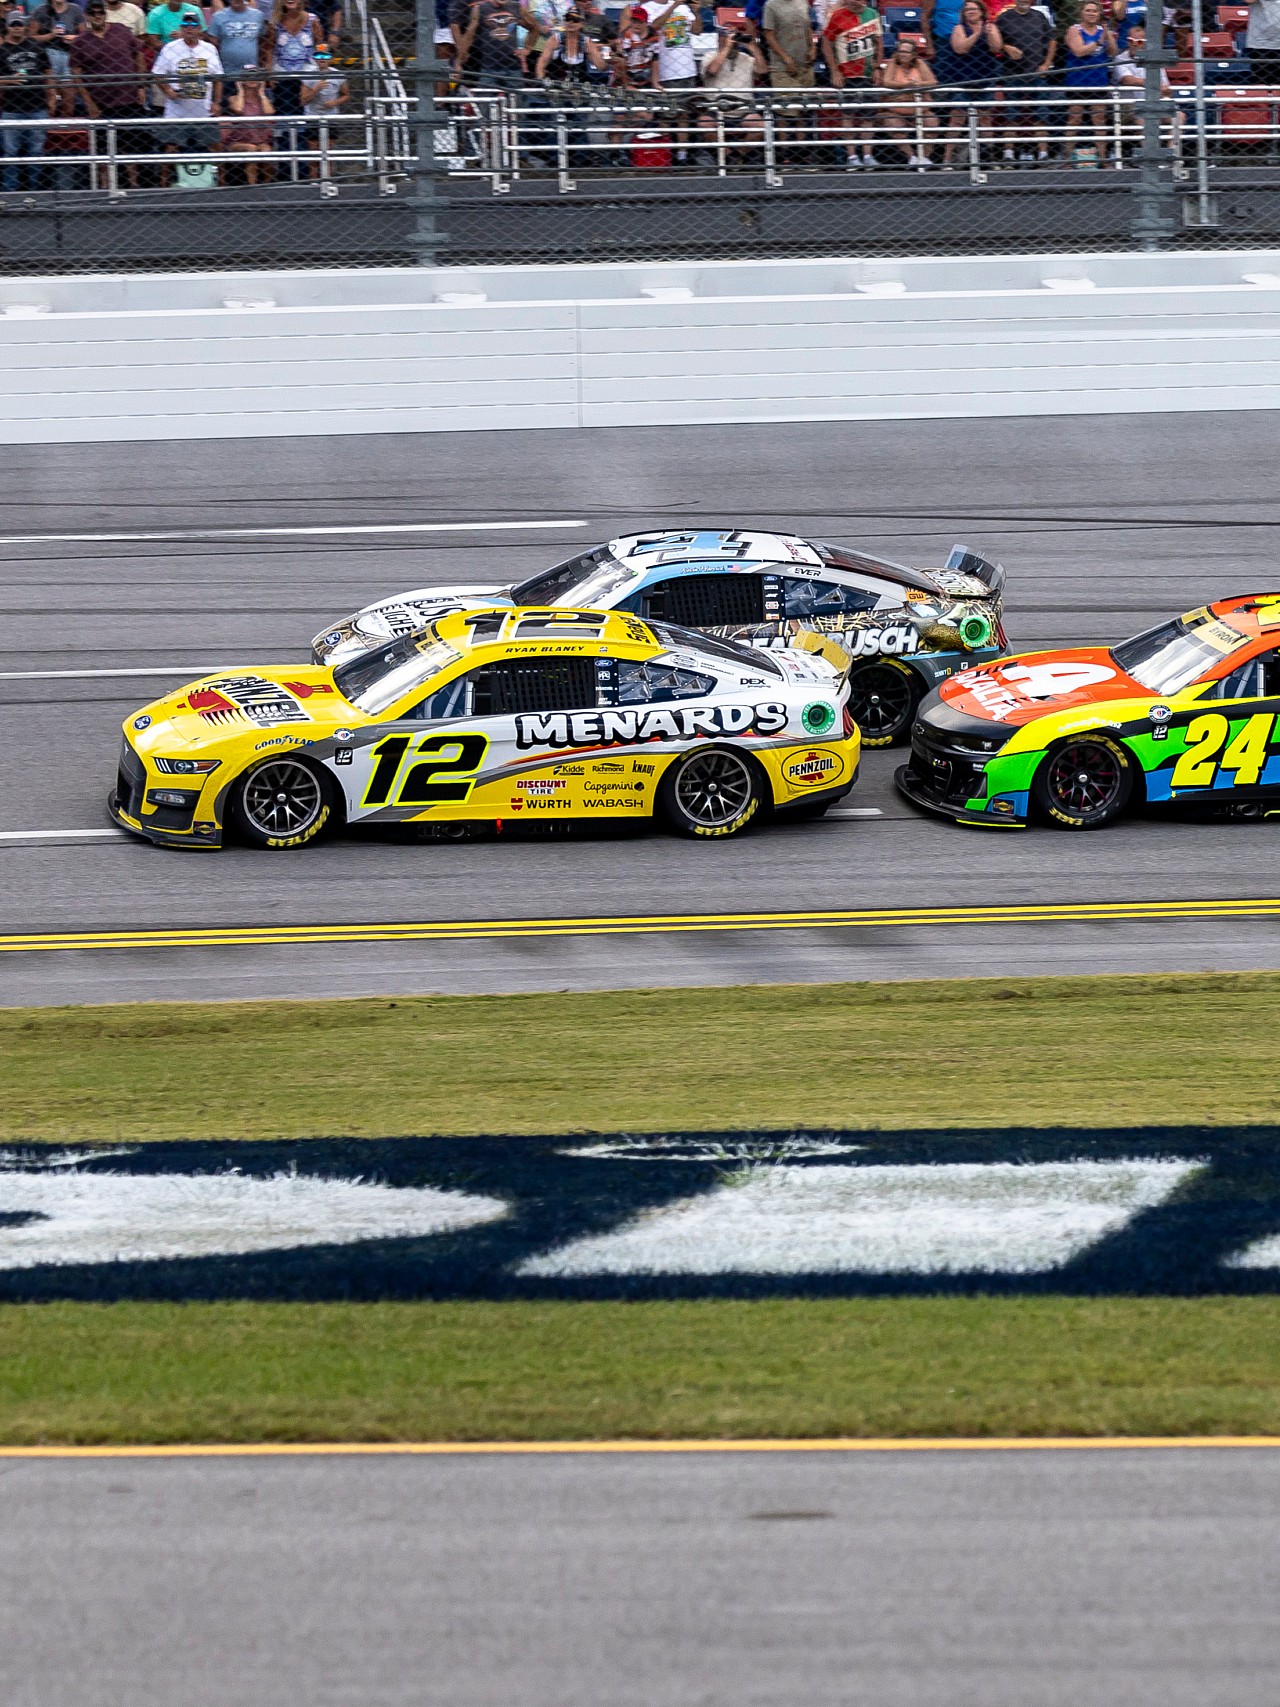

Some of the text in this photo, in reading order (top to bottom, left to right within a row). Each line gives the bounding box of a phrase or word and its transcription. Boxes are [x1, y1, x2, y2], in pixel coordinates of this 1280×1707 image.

[517, 703, 789, 749] MENARDS
[254, 735, 315, 751] GOODYEAR
[1170, 713, 1275, 787] 24
[336, 750, 351, 763] 12
[359, 732, 491, 809] 12
[562, 765, 585, 773] Kidde
[632, 760, 655, 777] KNAUF
[789, 758, 835, 777] PENNZOIL
[516, 780, 567, 788] DISCOUNT
[584, 781, 634, 794] Capgemini
[583, 800, 643, 808] WABASH
